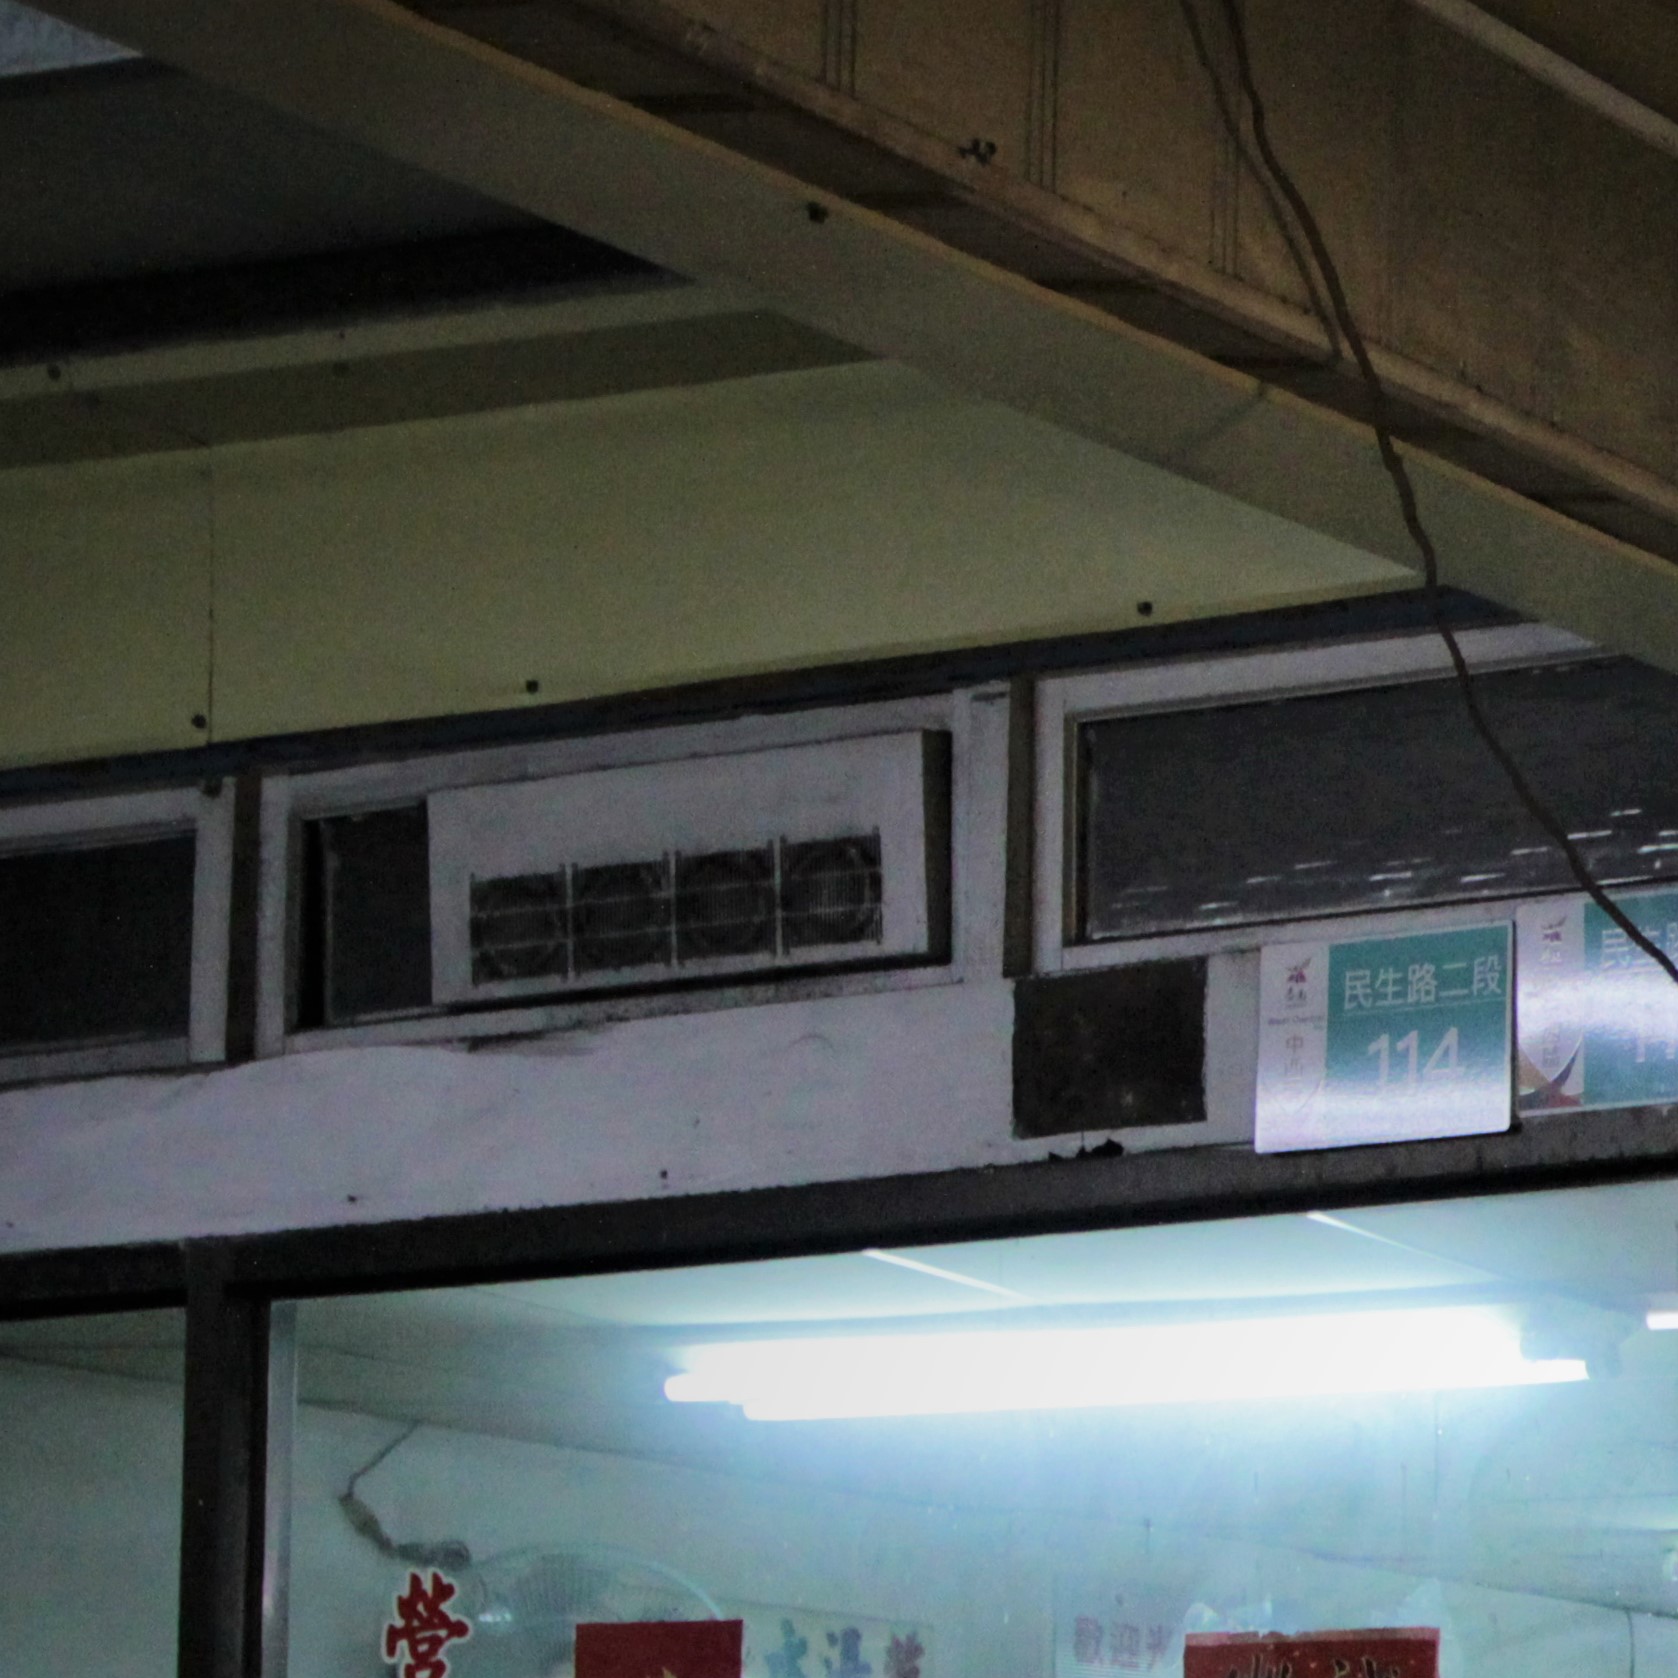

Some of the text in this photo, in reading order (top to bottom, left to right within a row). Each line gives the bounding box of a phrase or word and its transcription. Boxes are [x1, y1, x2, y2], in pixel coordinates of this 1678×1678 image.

[1343, 953, 1504, 1011] 民生路二段
[1367, 1026, 1466, 1099] 114
